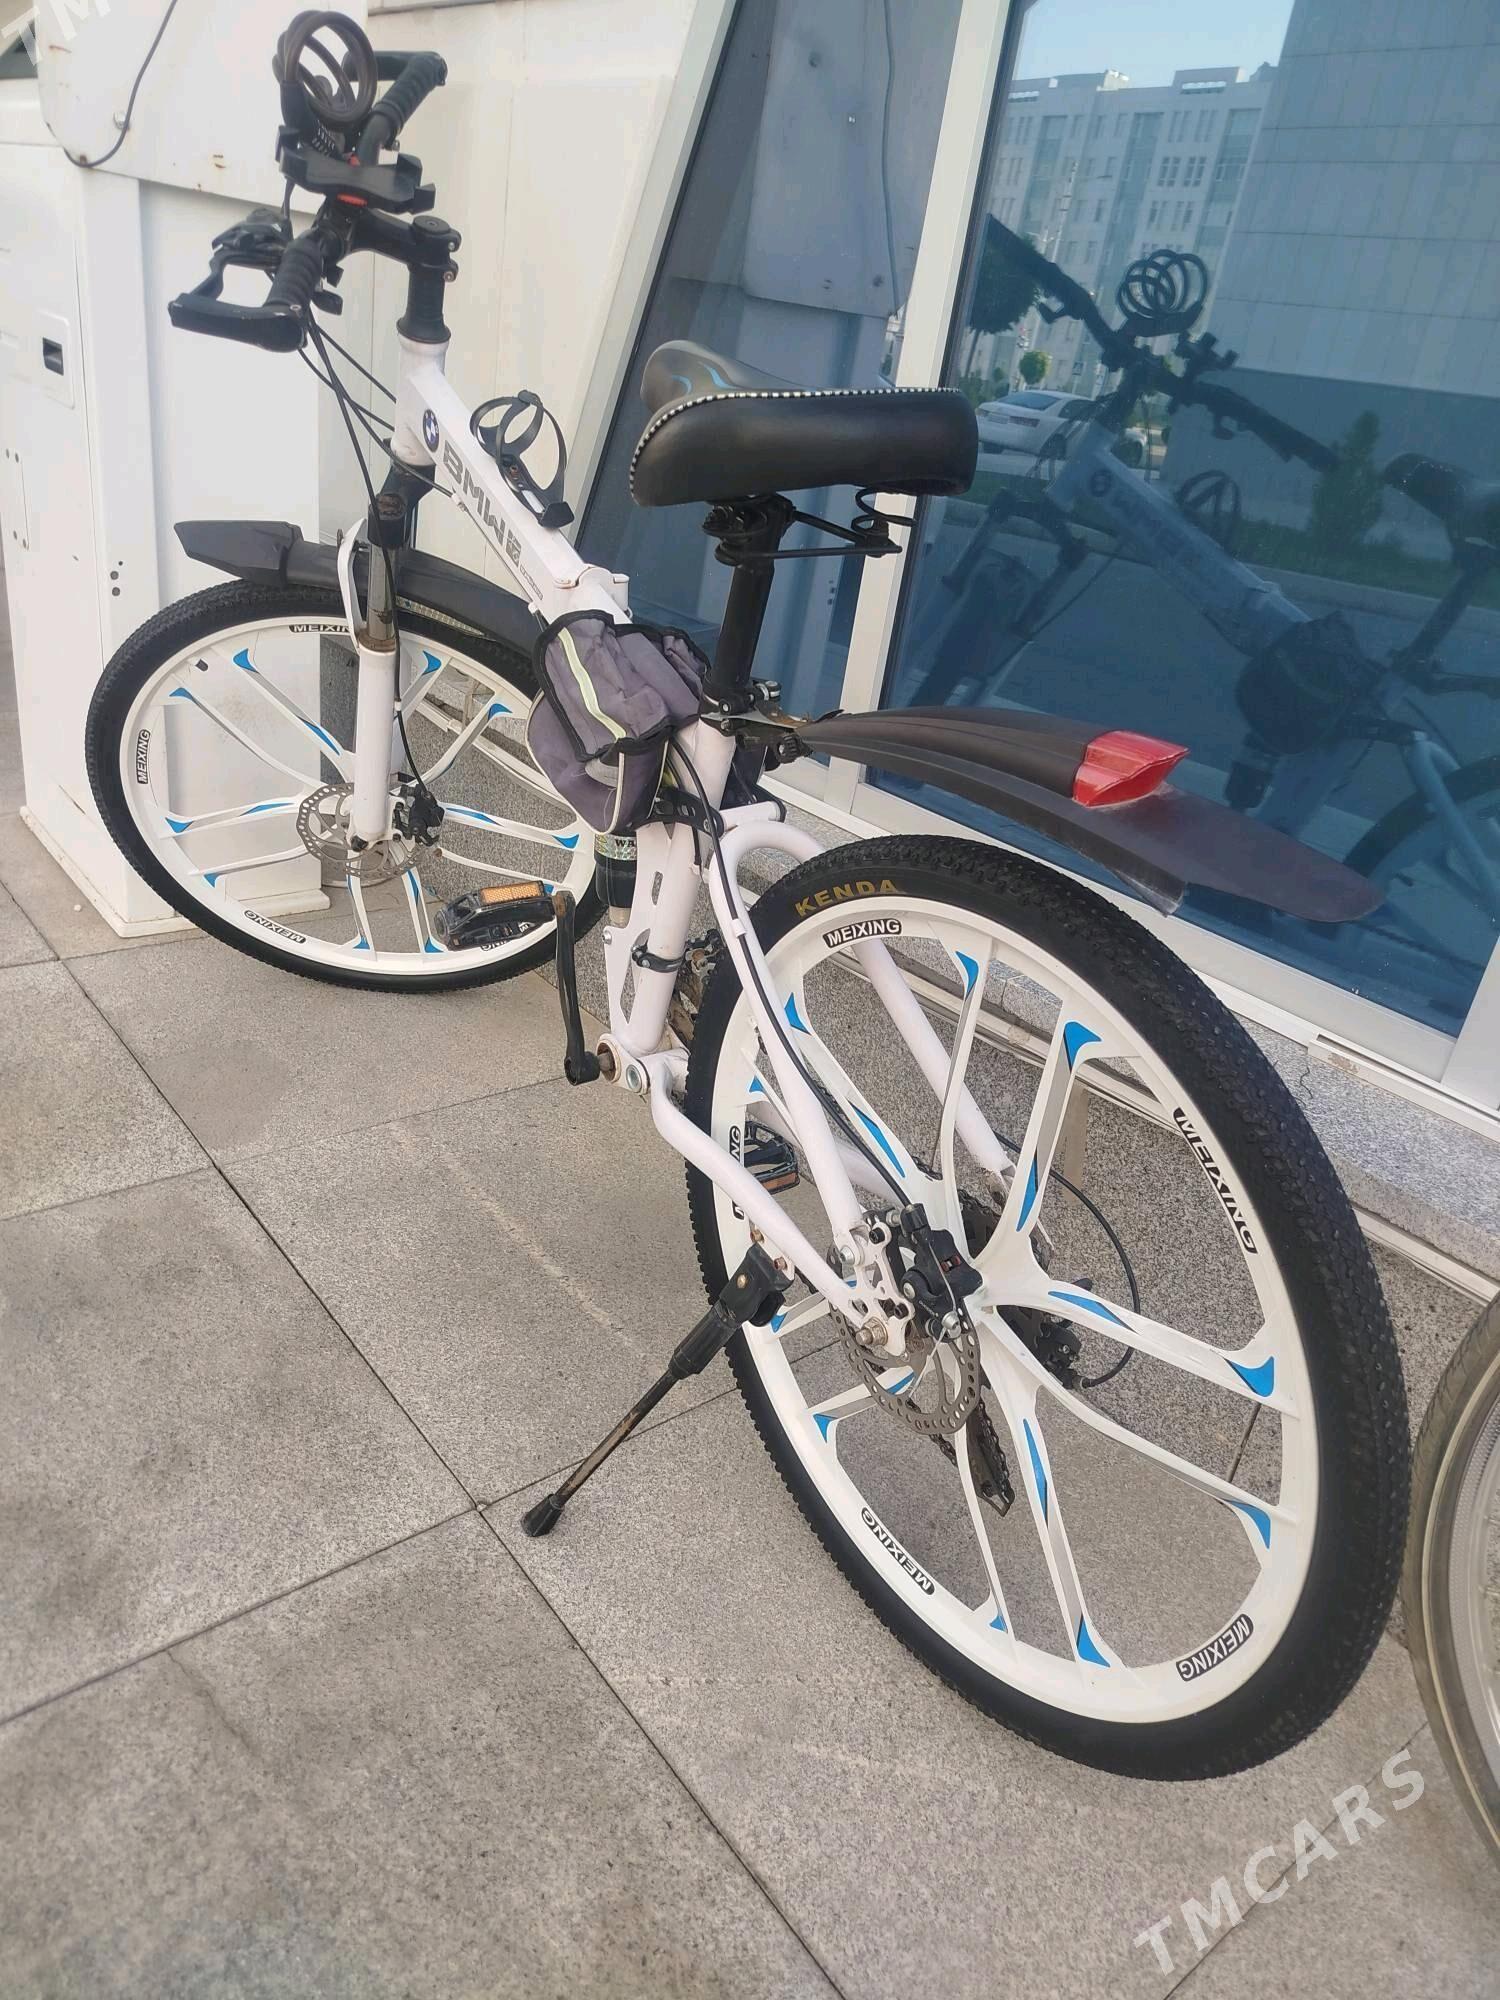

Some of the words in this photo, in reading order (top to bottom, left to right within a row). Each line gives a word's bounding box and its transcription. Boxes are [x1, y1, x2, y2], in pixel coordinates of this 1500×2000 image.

[443, 439, 506, 546] BMW
[293, 624, 351, 633] MEIXIN
[137, 729, 150, 784] MEIXING
[795, 879, 898, 917] KENDA
[244, 910, 305, 944] MEIXING
[827, 918, 901, 947] MEIXING
[1175, 1114, 1256, 1252] MEIXING
[862, 1508, 933, 1592] MEIXING
[1178, 1616, 1251, 1679] MEIXING
